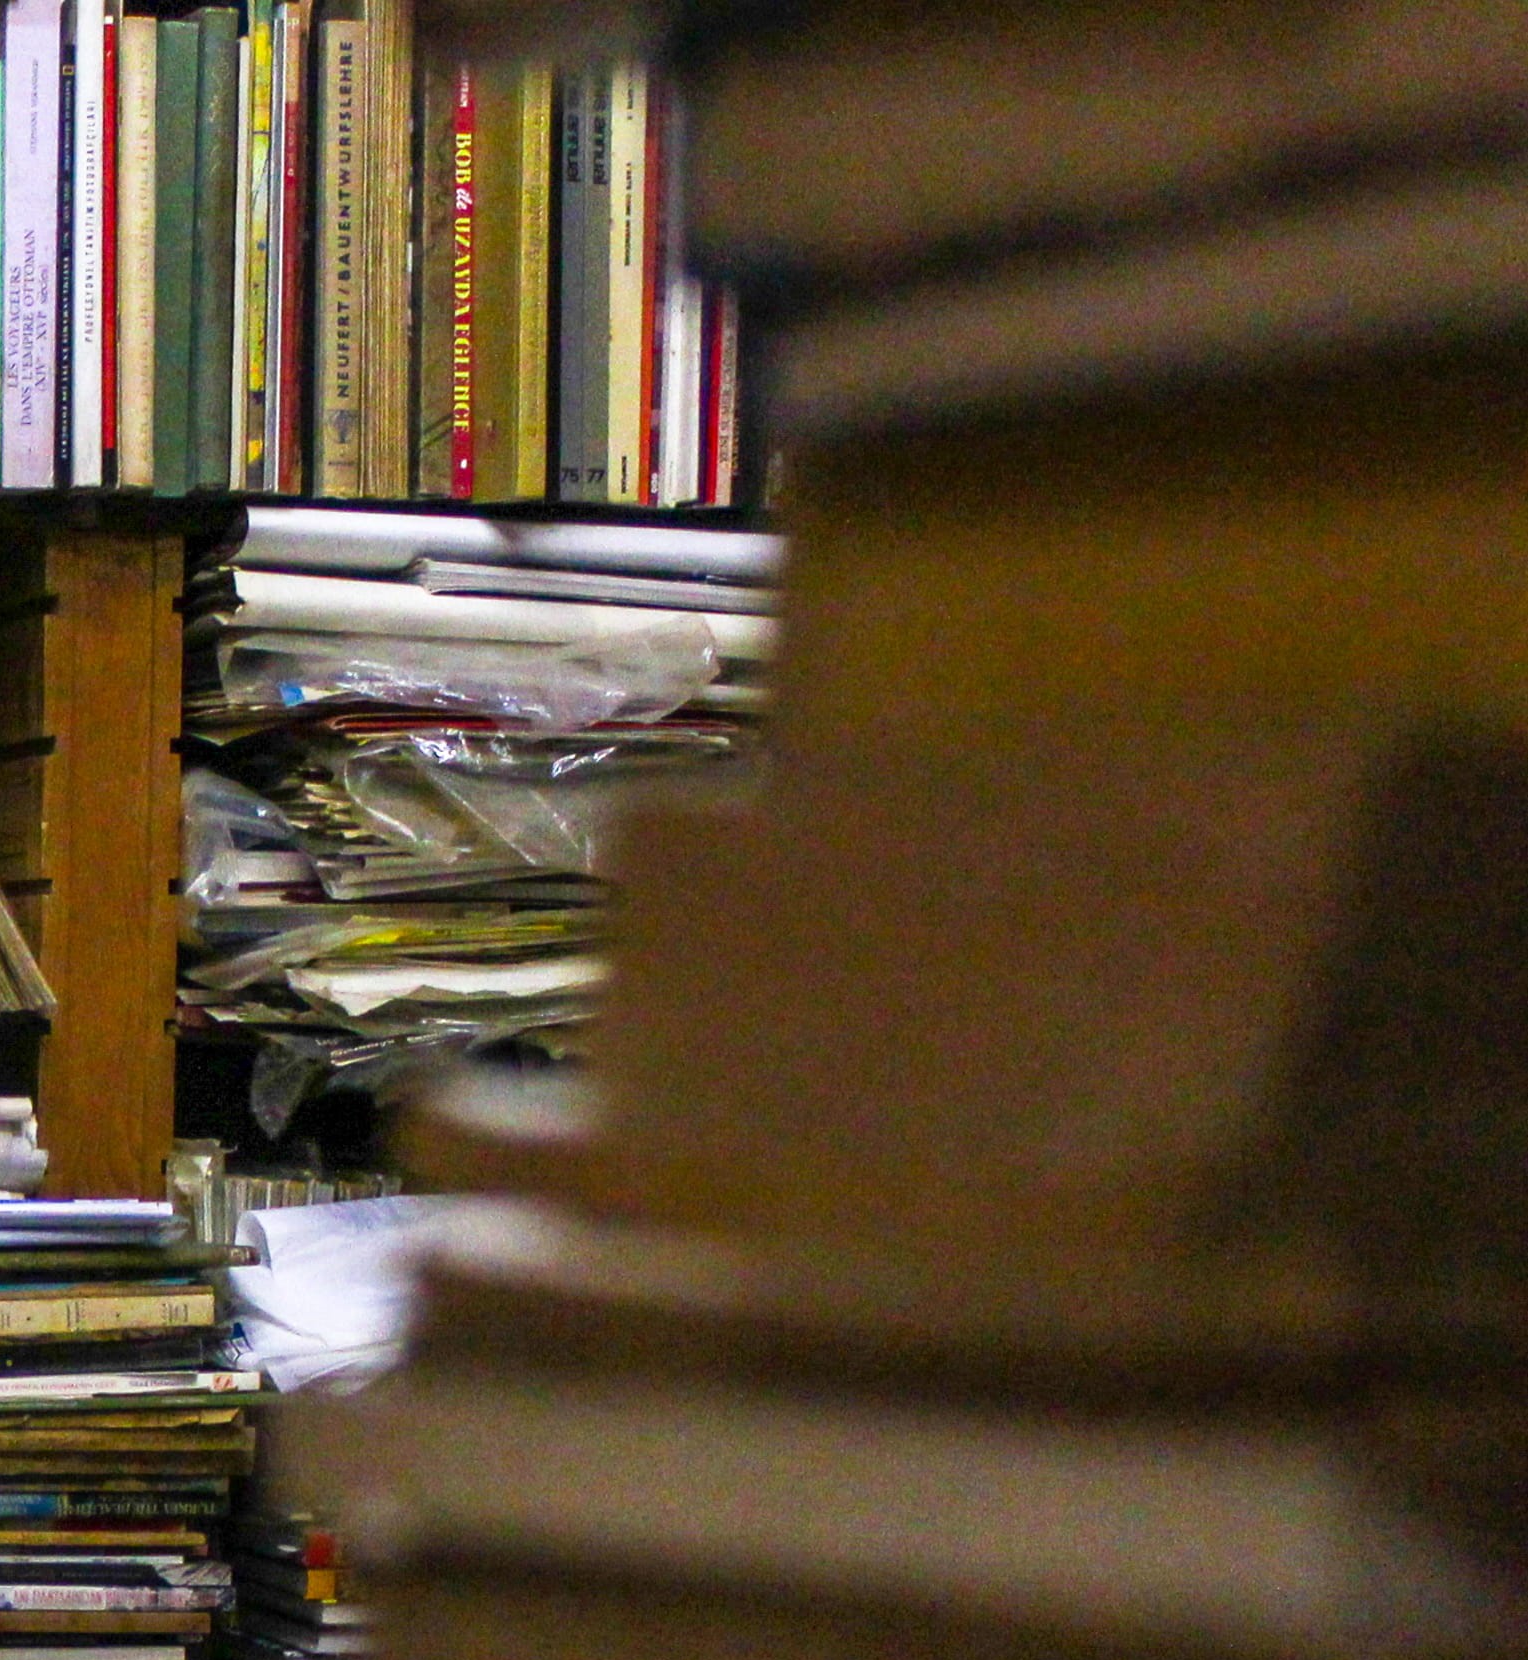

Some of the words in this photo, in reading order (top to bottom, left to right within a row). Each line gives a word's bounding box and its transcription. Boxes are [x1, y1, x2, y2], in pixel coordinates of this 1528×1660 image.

[335, 40, 353, 280] BAUENTWURFSLEHRE
[454, 133, 472, 184] BOB
[566, 114, 582, 184] annual
[592, 117, 607, 186] annual
[83, 206, 95, 256] TANITIM
[20, 227, 36, 308] OTTOMAN
[83, 261, 95, 342] PROFESYONEL
[454, 217, 472, 318] UZAYDA
[6, 265, 23, 357] VOYAGEURS
[6, 361, 22, 389] LES
[19, 311, 36, 382] L'EMPIRE
[335, 301, 351, 397] NEUFERT
[20, 385, 36, 426] DANS
[560, 468, 580, 484] 75
[587, 468, 606, 484] 77
